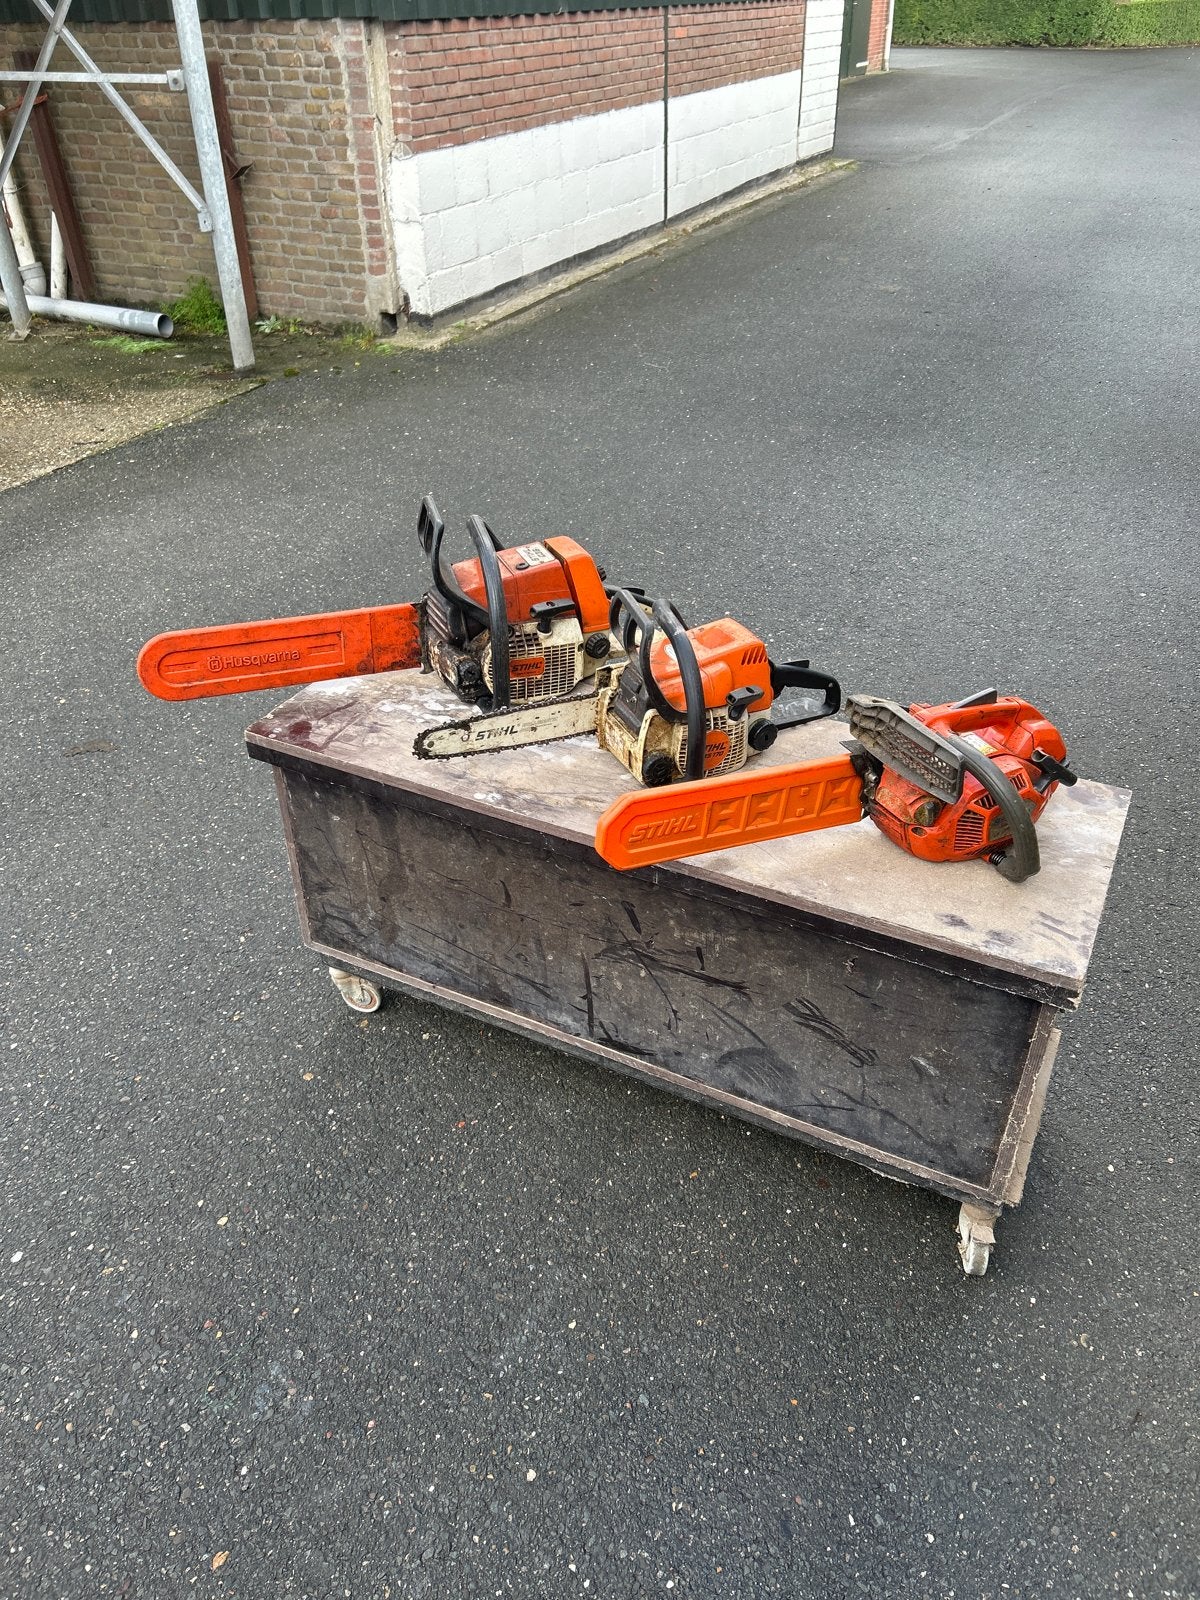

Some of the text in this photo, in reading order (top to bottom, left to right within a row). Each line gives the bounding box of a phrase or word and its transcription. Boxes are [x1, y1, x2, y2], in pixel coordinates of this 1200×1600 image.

[223, 650, 300, 669] Husqvarna
[511, 662, 541, 672] STIHL
[475, 725, 518, 741] STIHL
[705, 742, 727, 753] TIHL
[629, 815, 697, 843] STIHL
